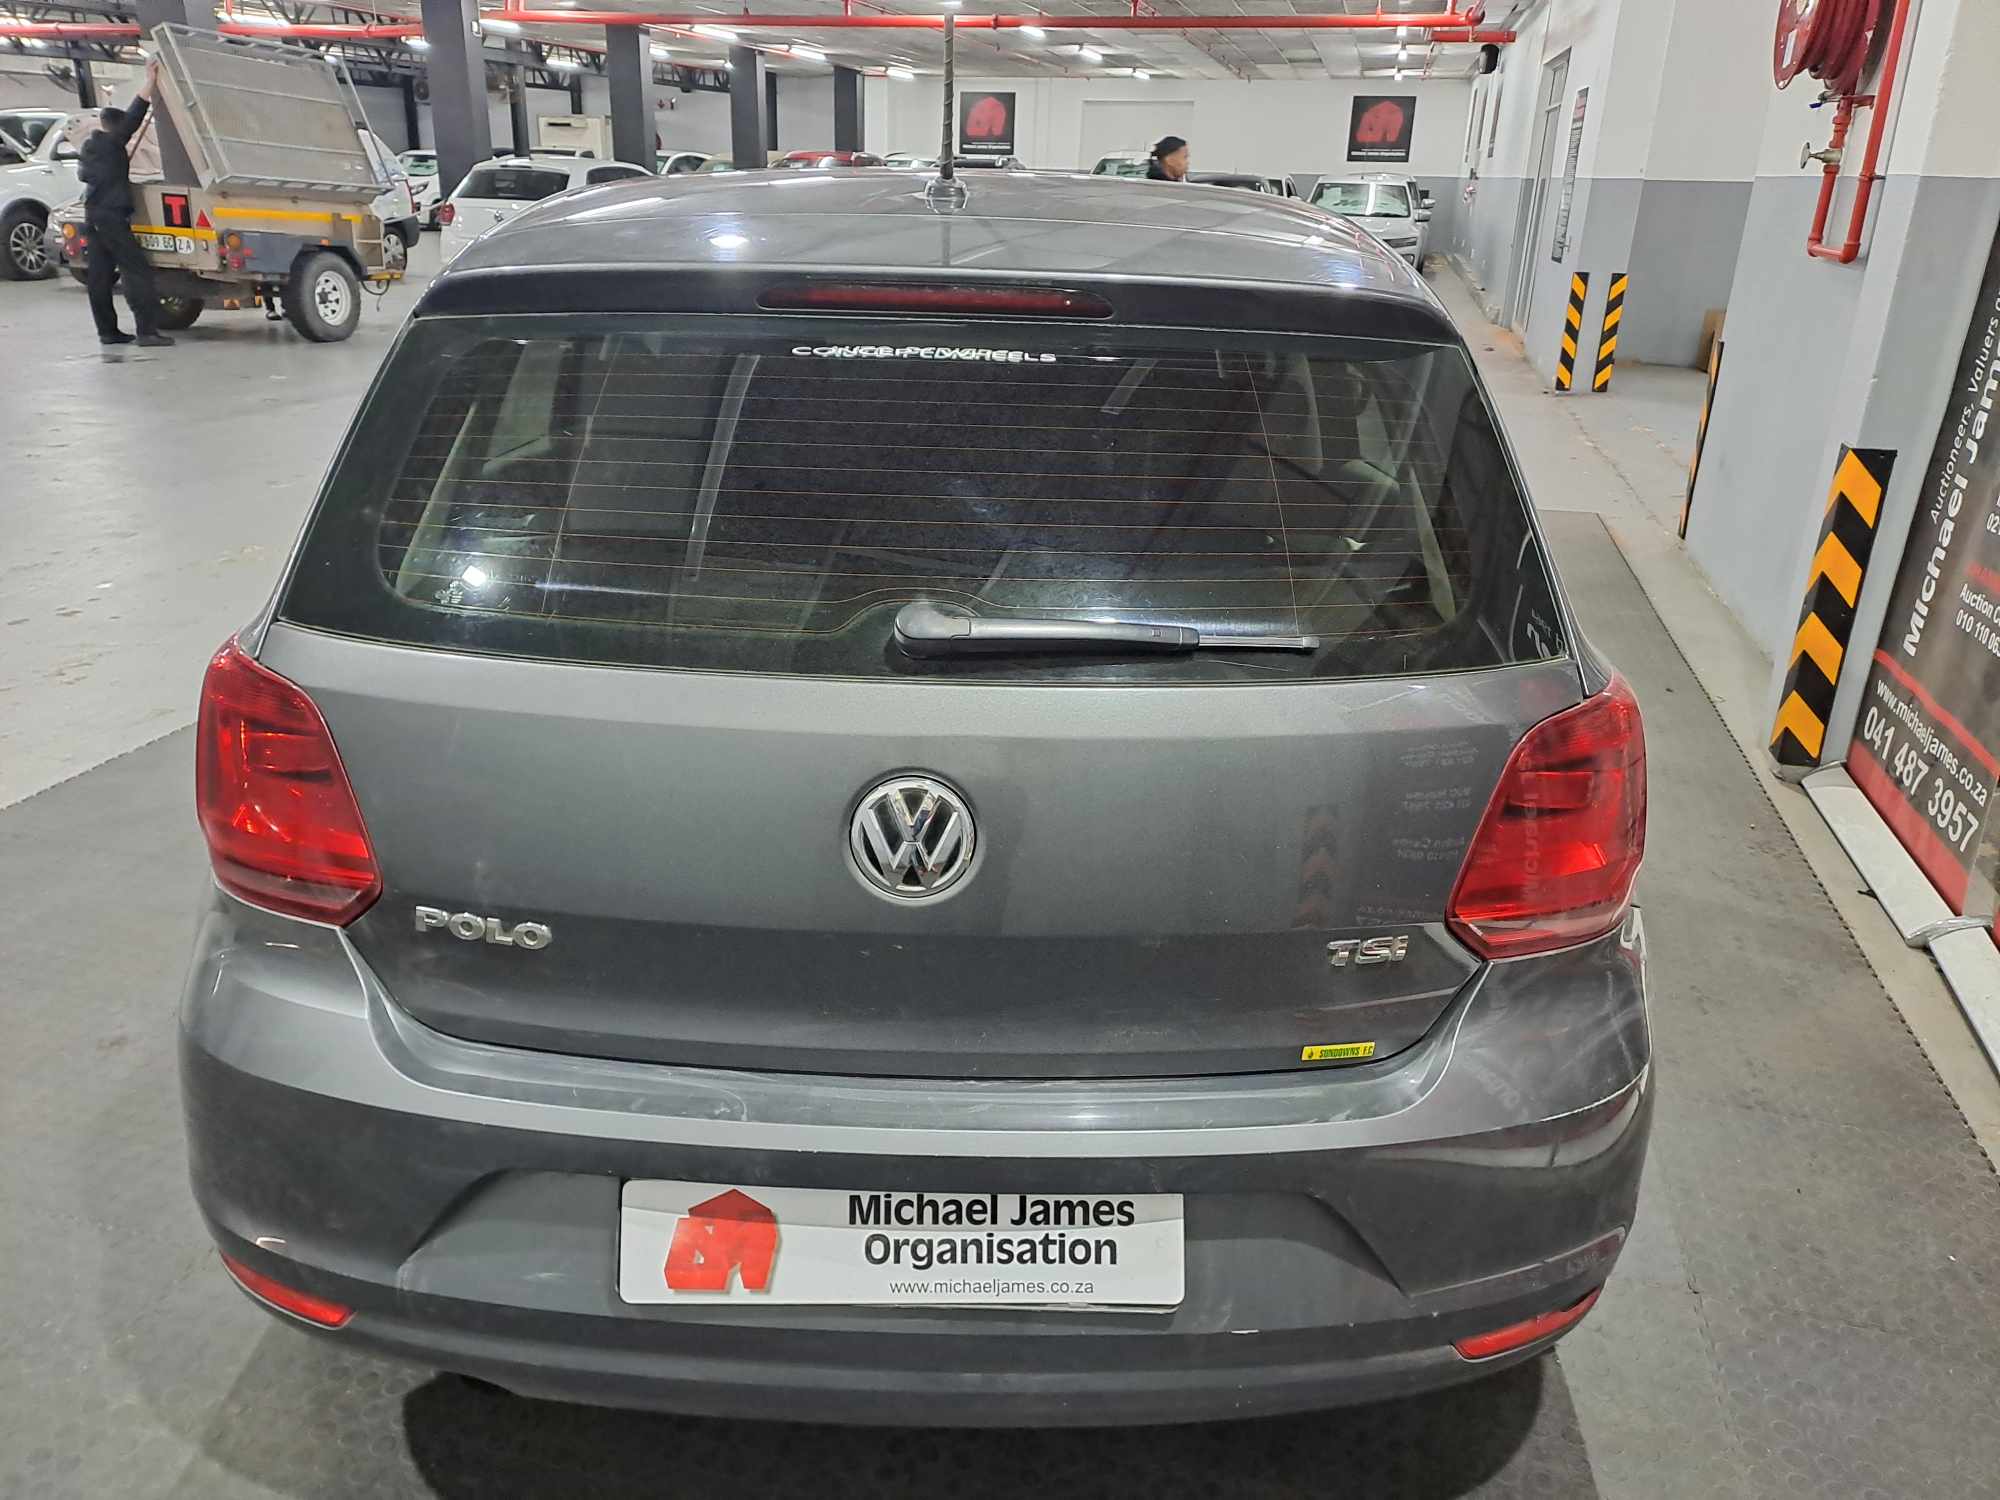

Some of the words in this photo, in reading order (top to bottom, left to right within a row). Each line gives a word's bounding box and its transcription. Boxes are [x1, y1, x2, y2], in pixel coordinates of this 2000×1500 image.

[164, 195, 186, 225] T
[1967, 316, 1999, 393] Valuers
[1903, 473, 1969, 657] Michael
[1965, 338, 2000, 464] Jam
[1955, 609, 1974, 633] 010
[1959, 583, 1993, 620] Auction
[1877, 679, 1988, 808] www.michaeljames.co.za
[1863, 706, 1895, 761] 041
[1894, 742, 1929, 796] 487
[1927, 777, 1980, 852] 3957
[415, 905, 553, 950] POLO
[848, 1193, 998, 1226] Michael
[1010, 1194, 1136, 1227] James
[864, 1232, 1118, 1271] Organisation
[889, 1279, 1095, 1297] www.michaeljames.co.za
